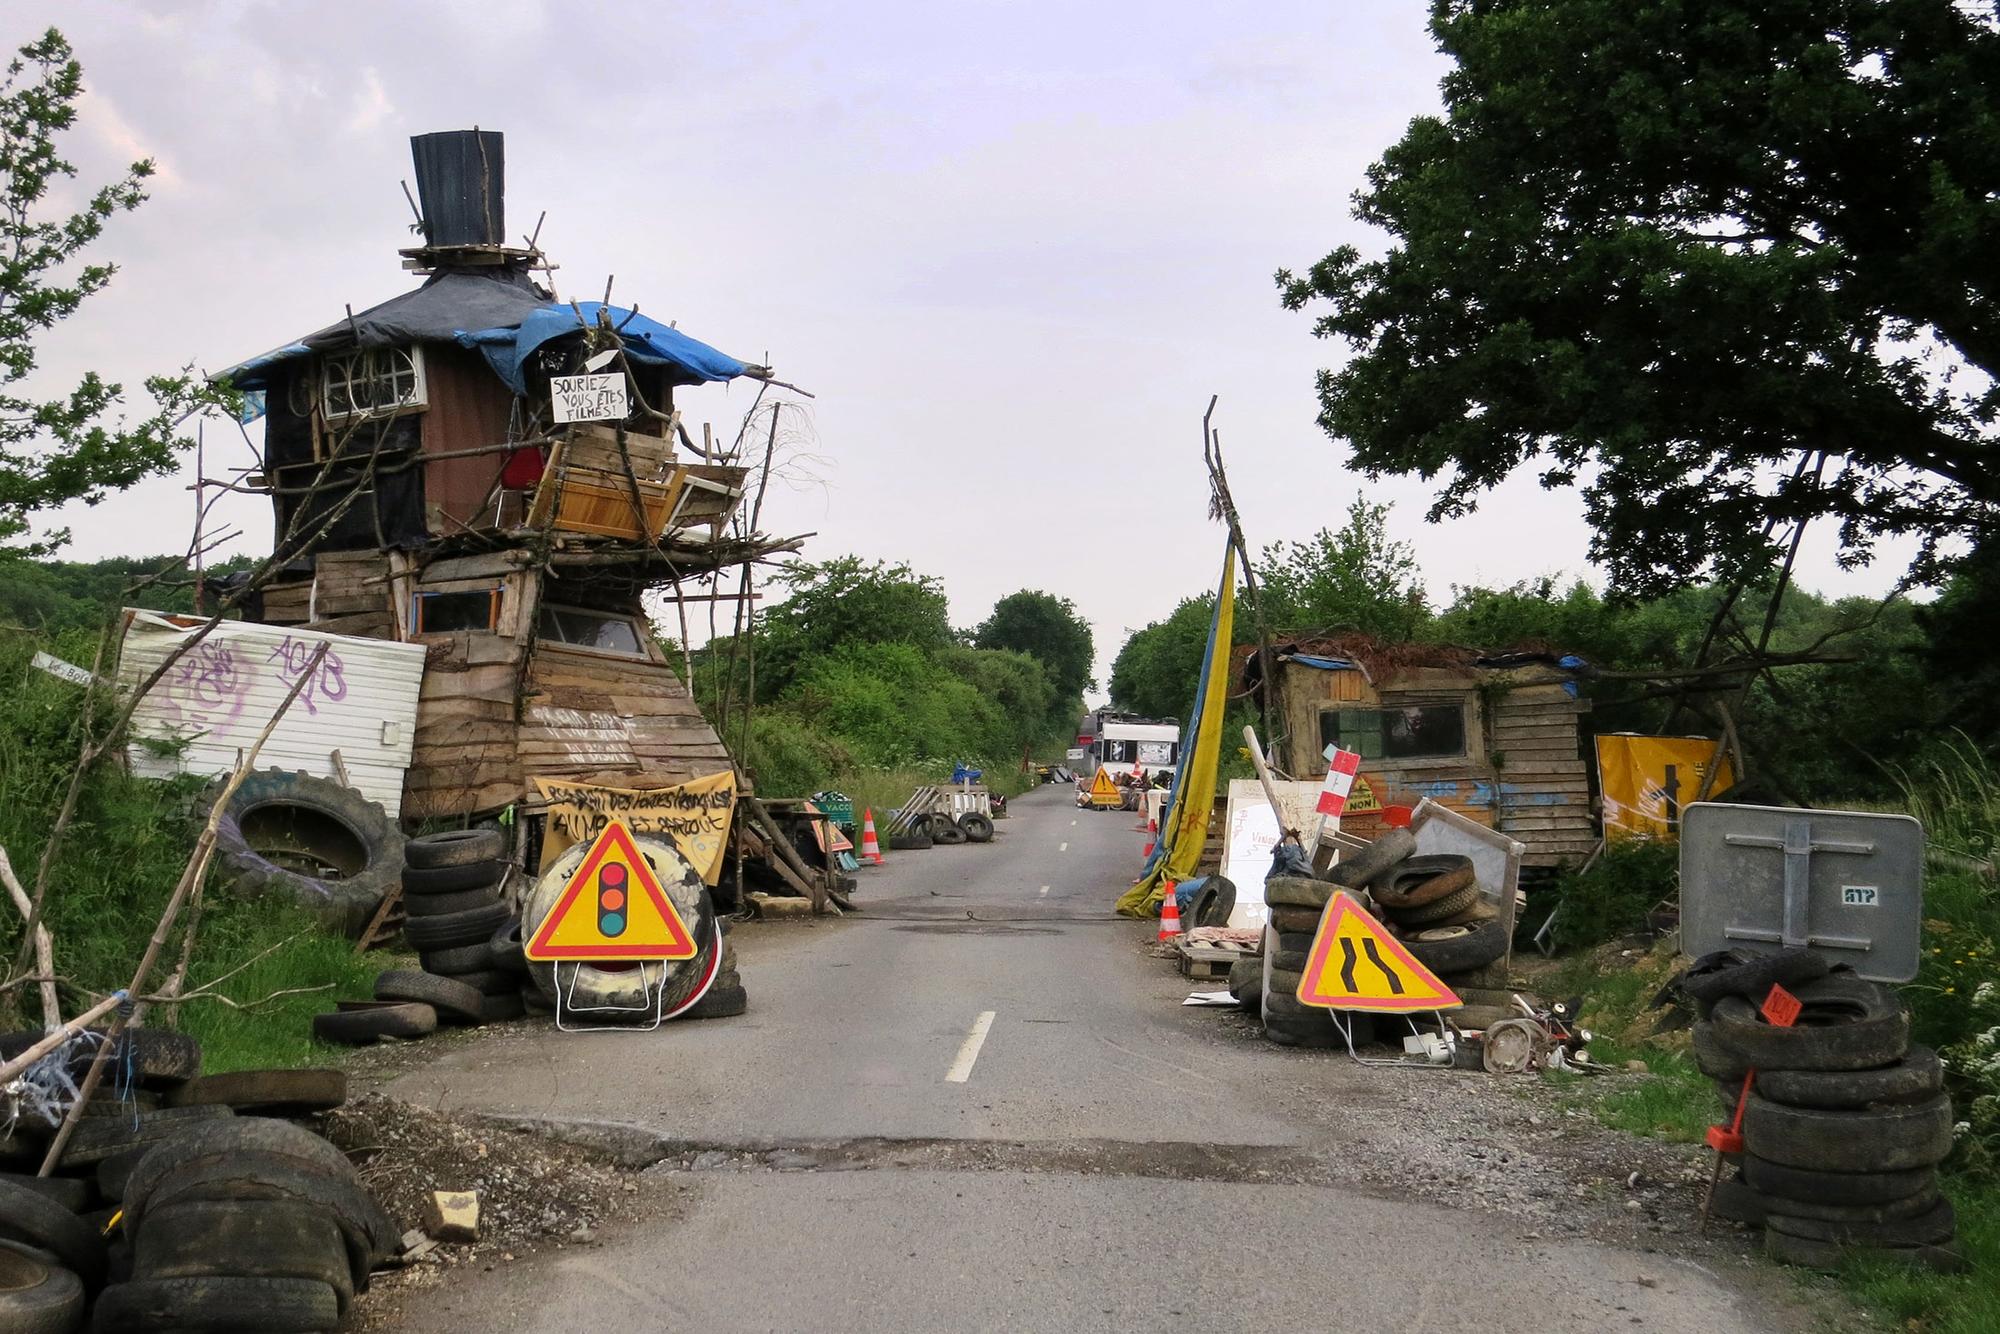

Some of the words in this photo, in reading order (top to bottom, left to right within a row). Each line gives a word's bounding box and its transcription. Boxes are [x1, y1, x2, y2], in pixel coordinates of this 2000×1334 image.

[554, 376, 610, 394] SOURIEZ
[562, 393, 593, 408] VOUS
[553, 813, 580, 840] AU
[582, 814, 621, 841] MA
